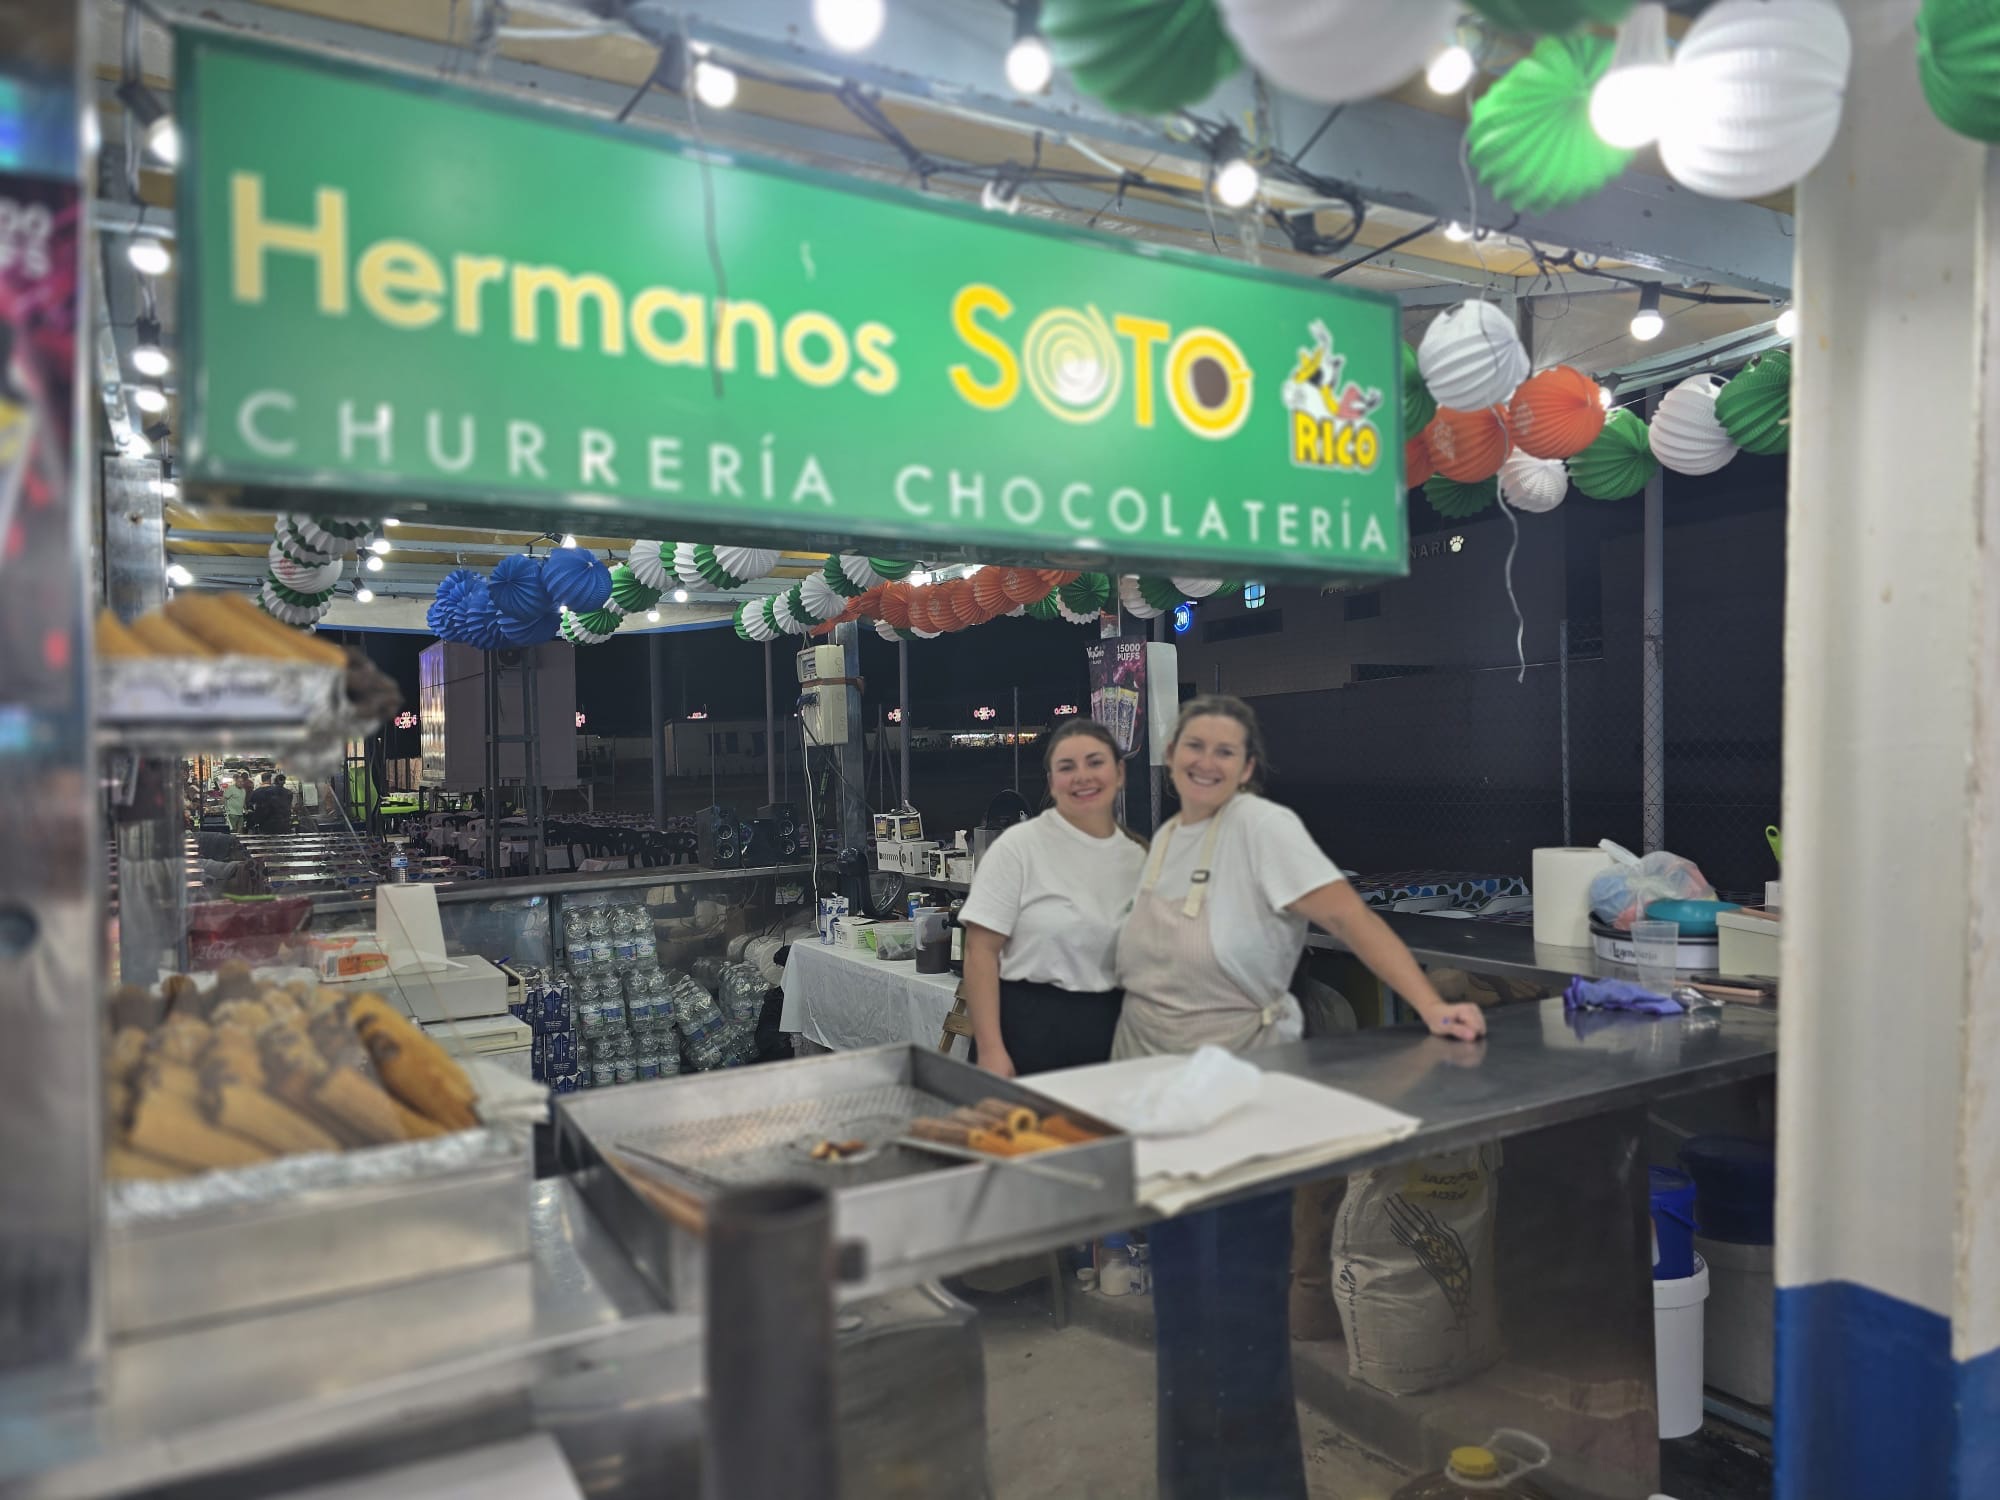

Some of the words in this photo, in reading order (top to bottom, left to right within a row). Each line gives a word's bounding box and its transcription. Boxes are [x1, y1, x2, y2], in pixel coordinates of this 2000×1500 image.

[231, 173, 898, 394] Hermanos
[949, 284, 1254, 440] SOTO
[1294, 410, 1378, 469] RICO
[237, 390, 834, 505] CHURRERÍA
[894, 463, 1387, 553] CHOCOLATERÍA
[1116, 643, 1141, 653] 15000
[1116, 652, 1141, 661] PUFFS
